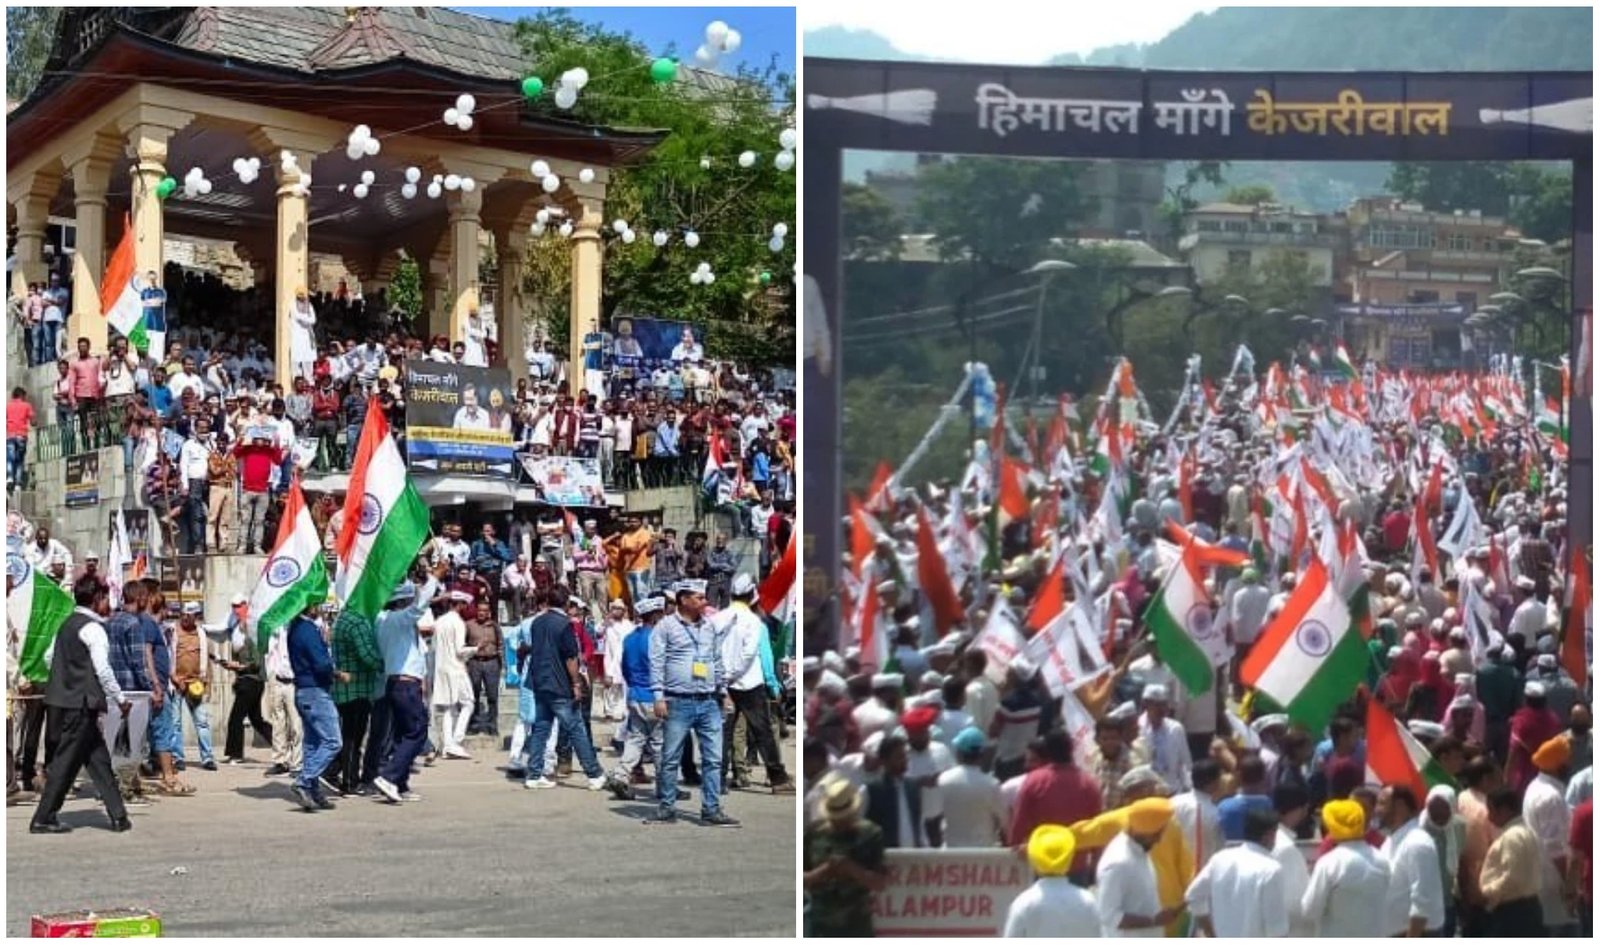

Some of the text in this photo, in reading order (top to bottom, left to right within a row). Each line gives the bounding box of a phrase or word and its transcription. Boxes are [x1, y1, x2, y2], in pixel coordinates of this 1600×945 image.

[975, 83, 1452, 137] हिमाचल माँगे केजरीवाल
[883, 864, 1021, 887] RAMSHALA
[868, 894, 993, 917] ALAMPUR
